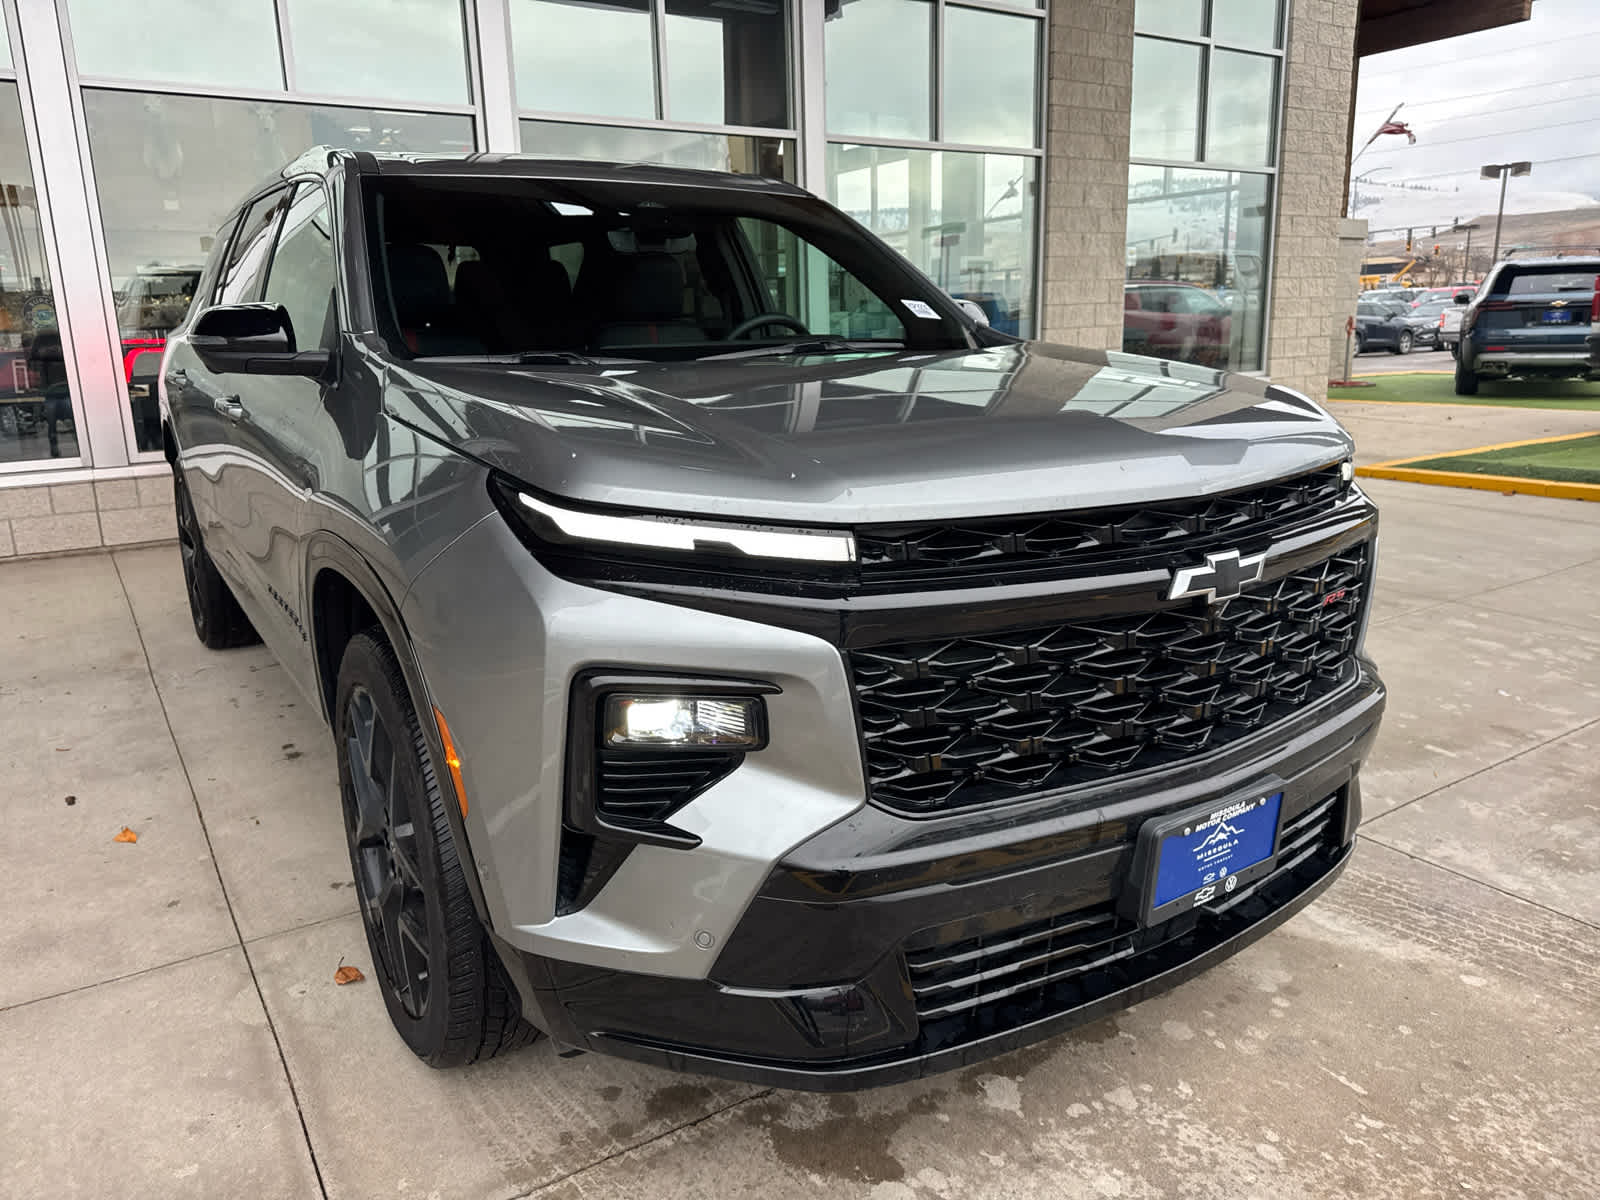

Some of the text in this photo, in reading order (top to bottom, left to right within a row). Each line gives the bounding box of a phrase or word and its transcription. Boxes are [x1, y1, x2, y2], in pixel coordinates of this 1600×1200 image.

[1195, 802, 1256, 832] MOTOR COMPANY
[1210, 801, 1246, 820] MISSOULA
